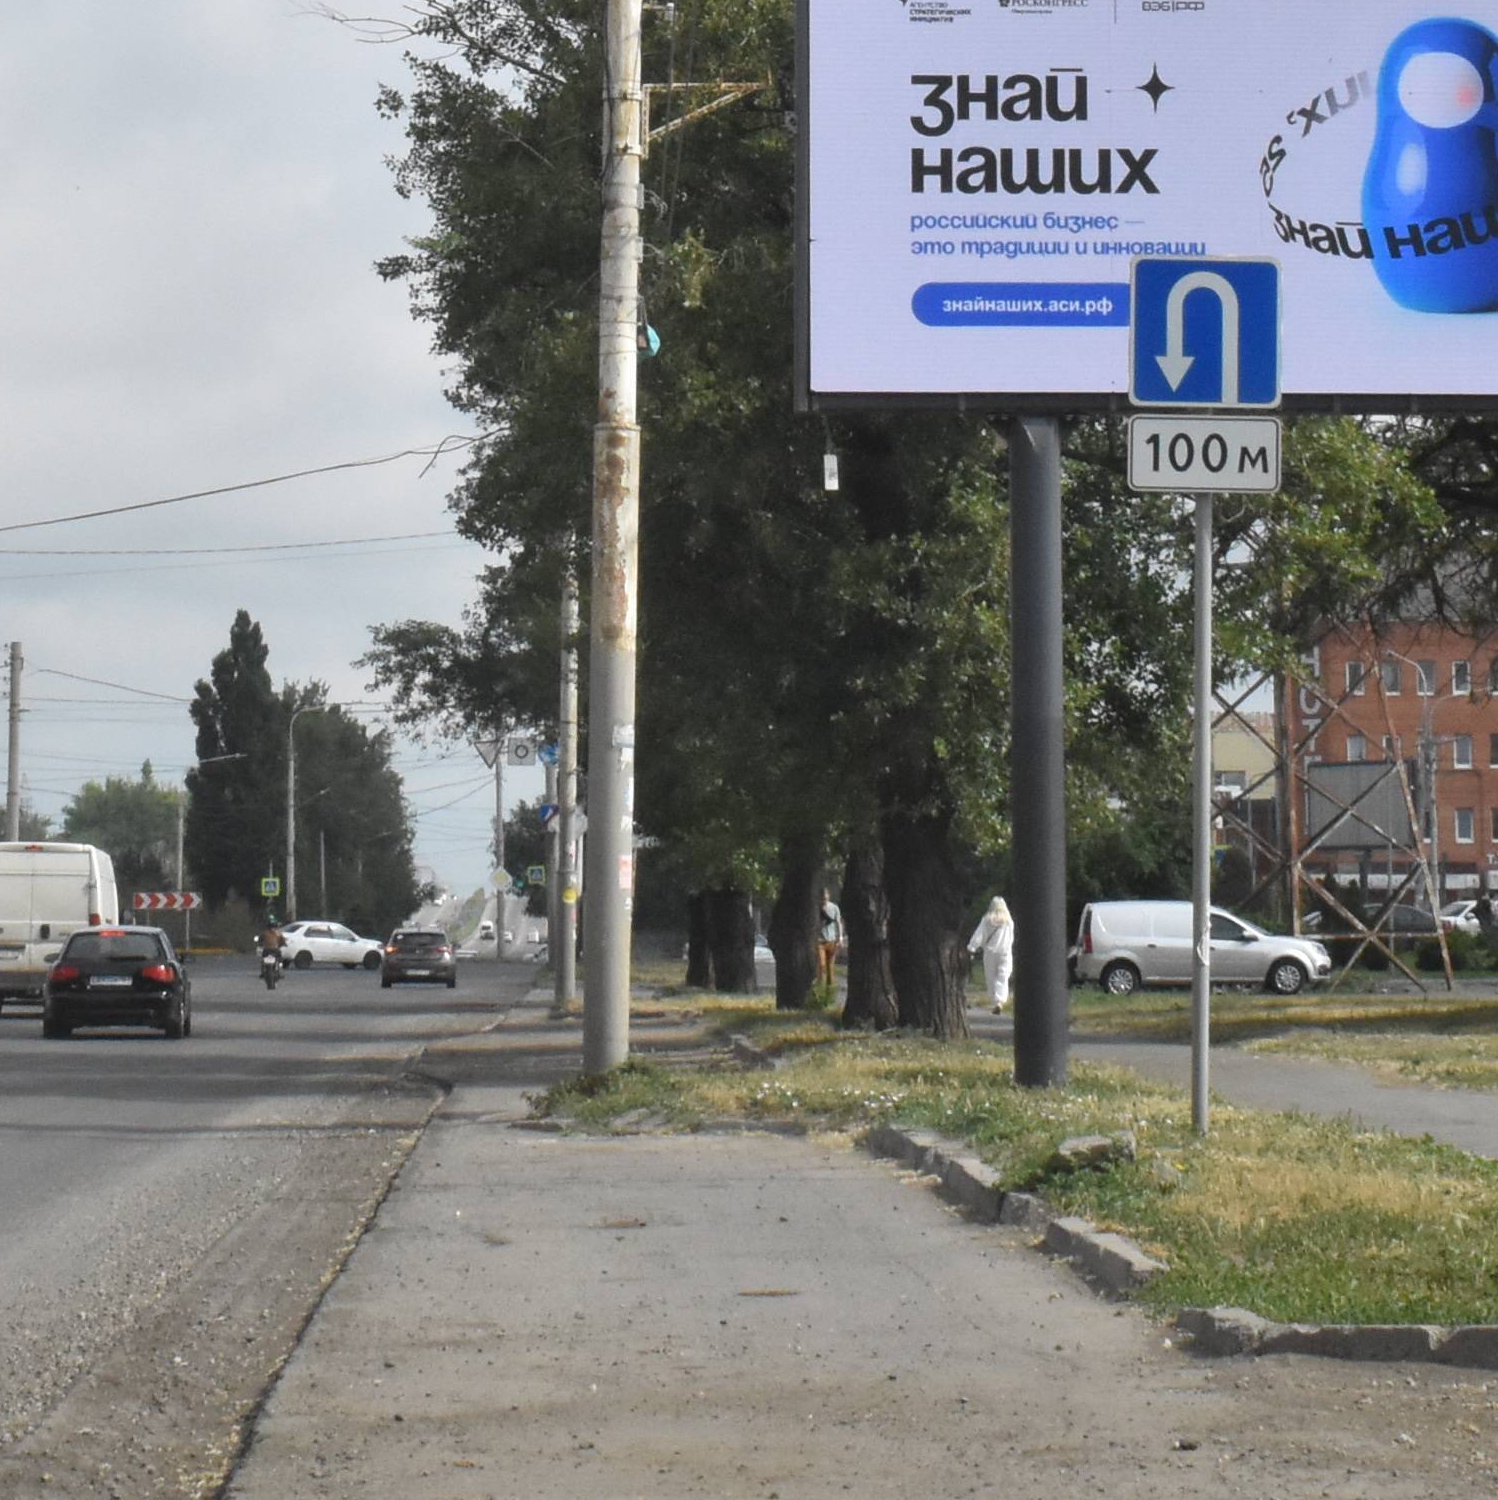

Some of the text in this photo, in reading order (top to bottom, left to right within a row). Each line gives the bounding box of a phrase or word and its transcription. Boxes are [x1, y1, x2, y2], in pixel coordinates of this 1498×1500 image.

[910, 68, 1088, 137] знай
[910, 146, 1161, 195] наших
[910, 212, 1038, 233] российский
[1042, 211, 1119, 234] бизнес
[1267, 201, 1375, 260] знай
[910, 240, 1207, 259] это традиции и инновации
[942, 296, 1113, 316] знайнаших.аси.рф
[1145, 432, 1228, 473] 100
